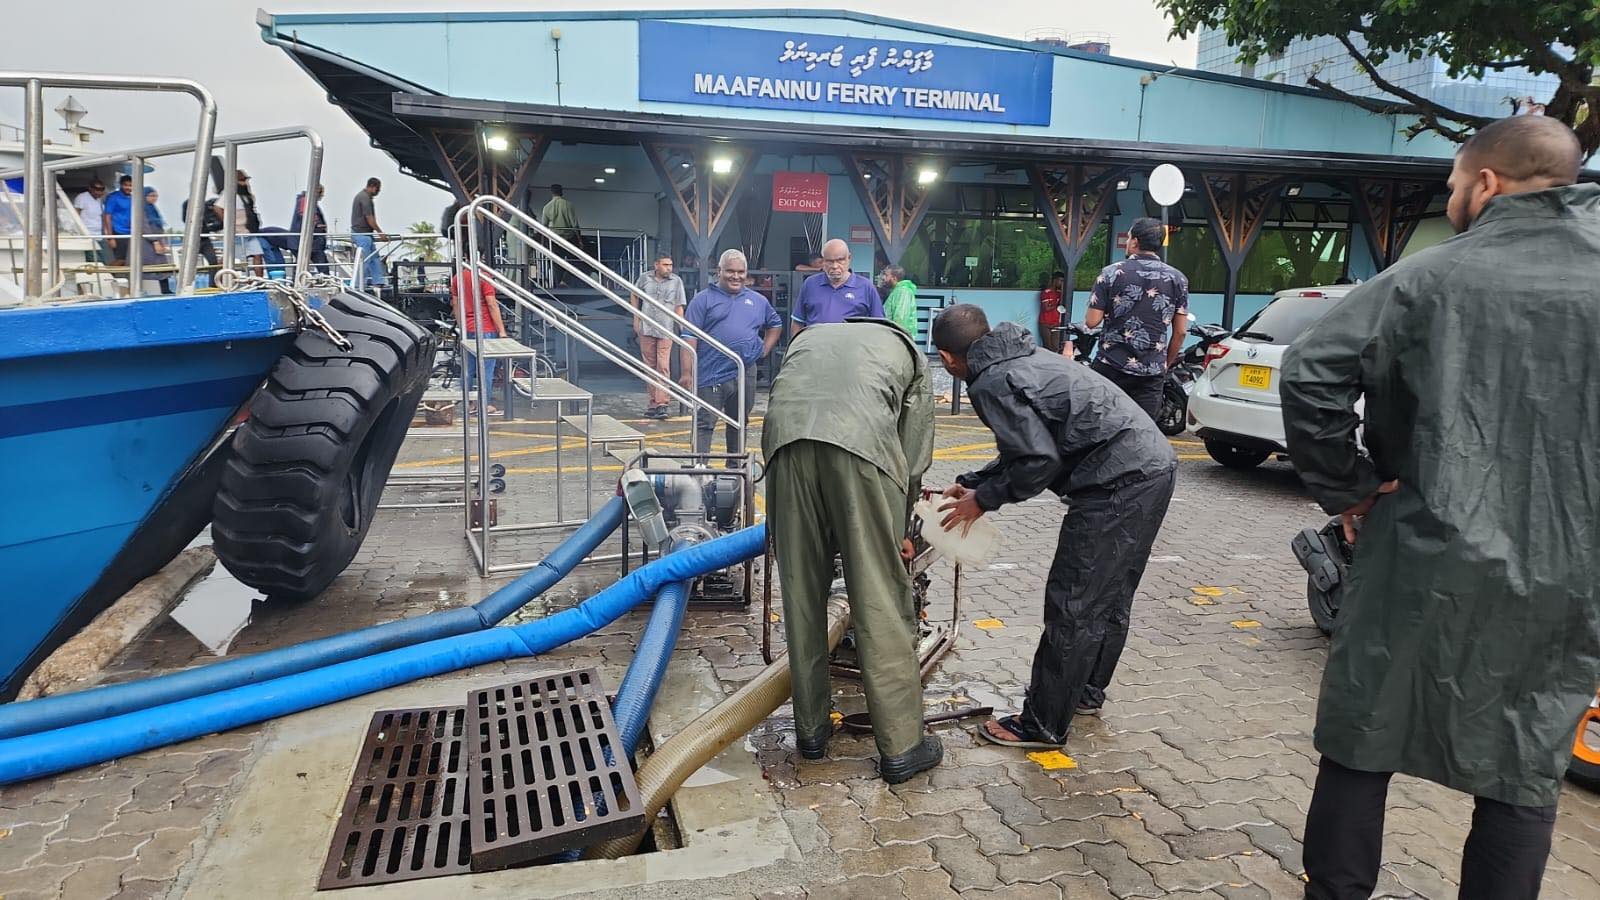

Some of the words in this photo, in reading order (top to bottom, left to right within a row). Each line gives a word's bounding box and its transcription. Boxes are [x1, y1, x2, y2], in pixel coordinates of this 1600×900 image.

[694, 73, 821, 101] MAAFANNU
[827, 82, 899, 105] FERRY
[902, 87, 1006, 112] TERMINAL
[778, 198, 798, 207] EXIT
[798, 199, 823, 208] ONLY
